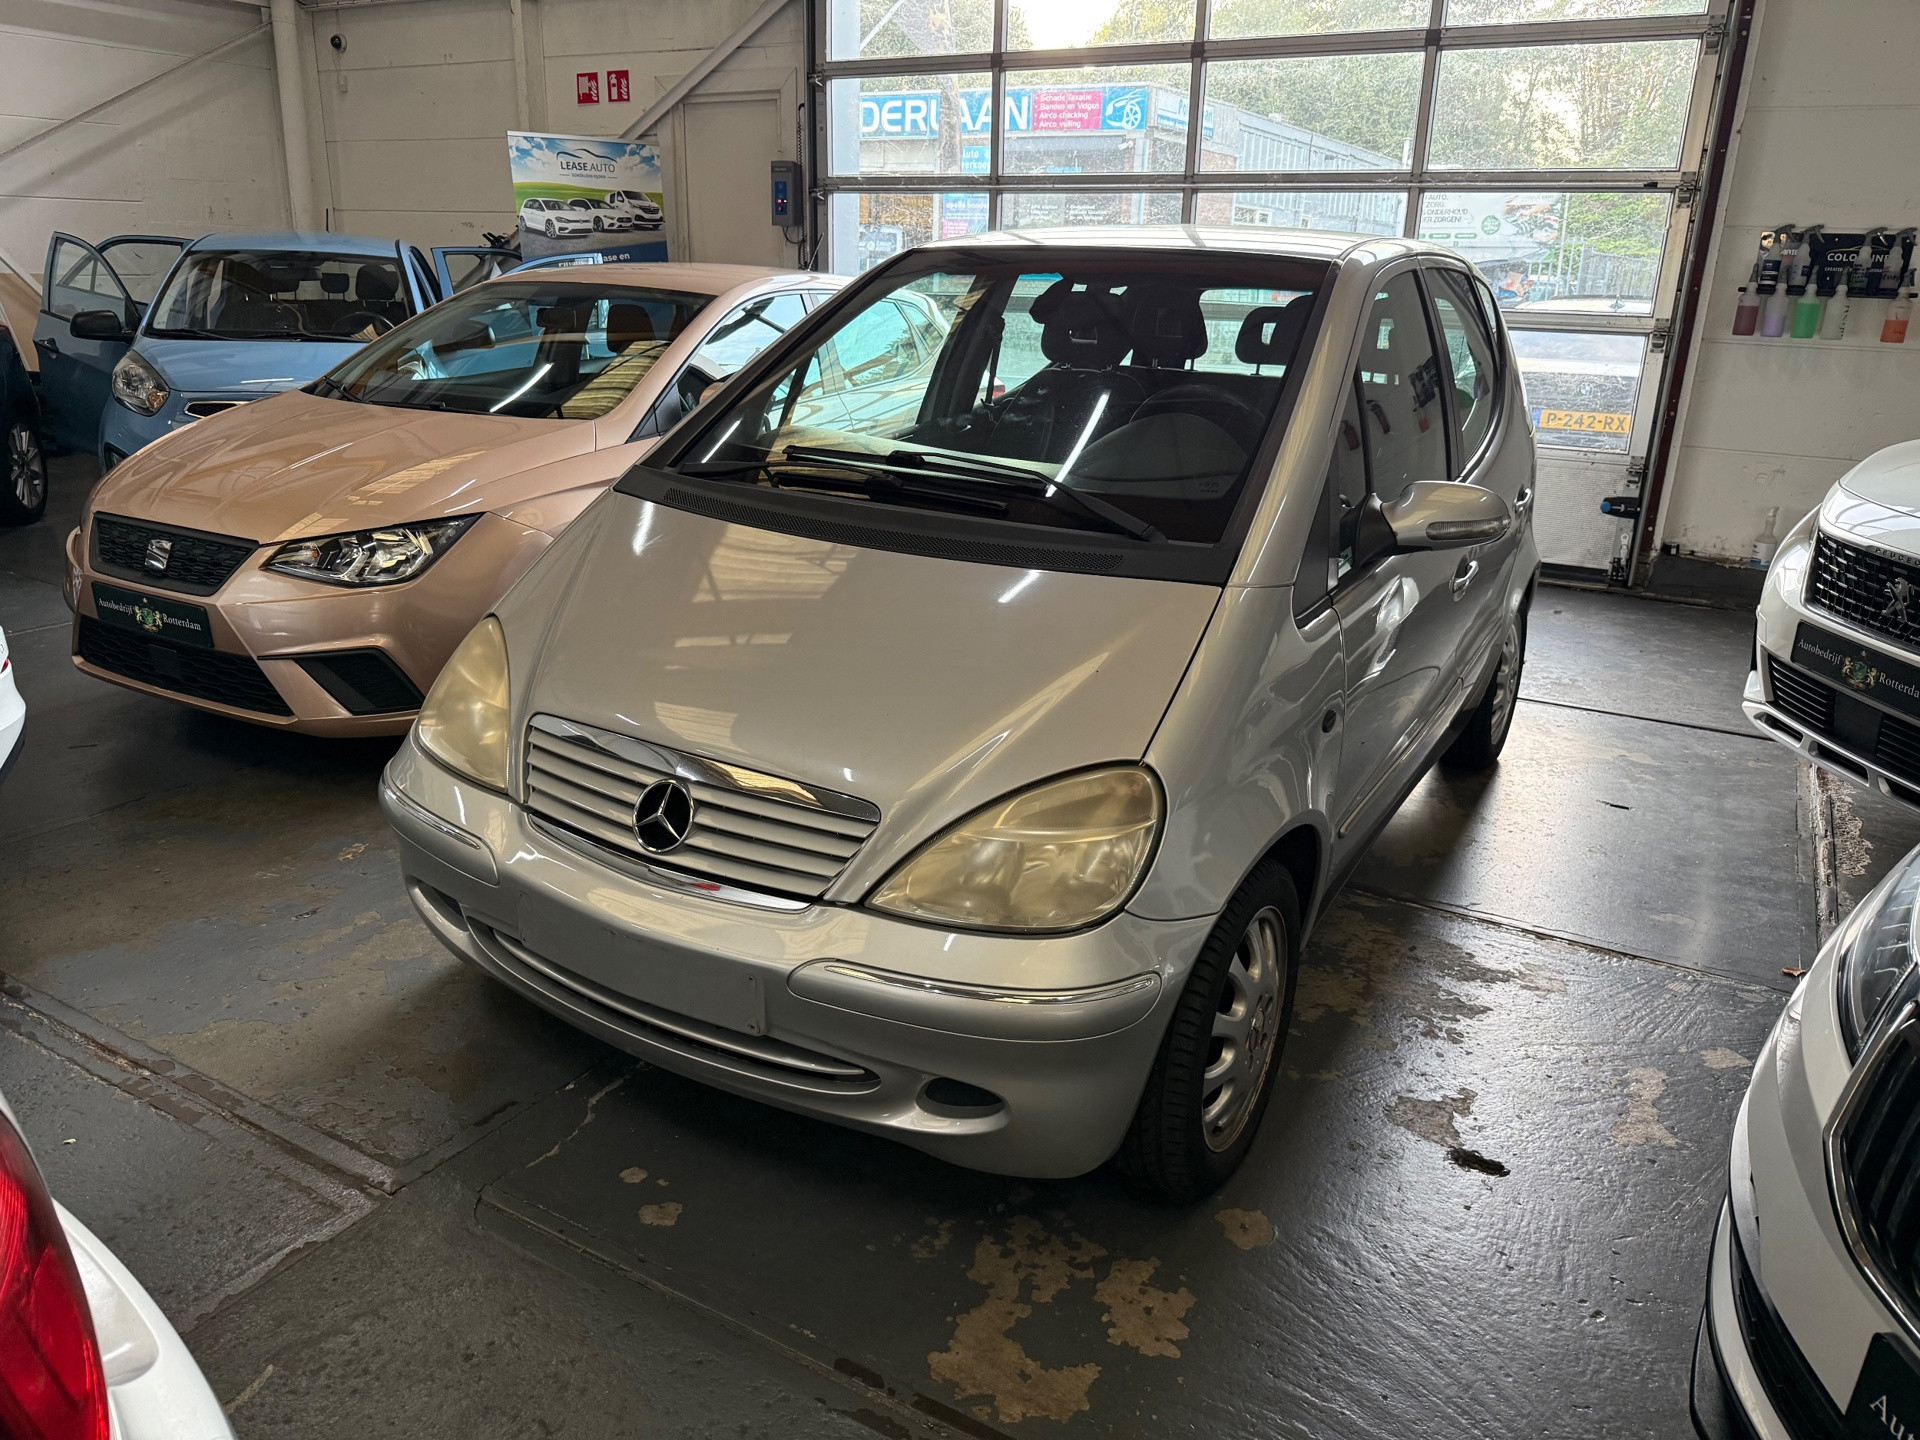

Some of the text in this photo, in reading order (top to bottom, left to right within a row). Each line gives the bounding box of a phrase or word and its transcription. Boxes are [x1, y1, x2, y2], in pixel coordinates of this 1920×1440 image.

[1077, 103, 1100, 111] Velgen
[1547, 413, 1626, 431] P-242-RX
[98, 597, 201, 631] Autobedrijf Rotterdam
[1798, 638, 1842, 664] Autobedrijf
